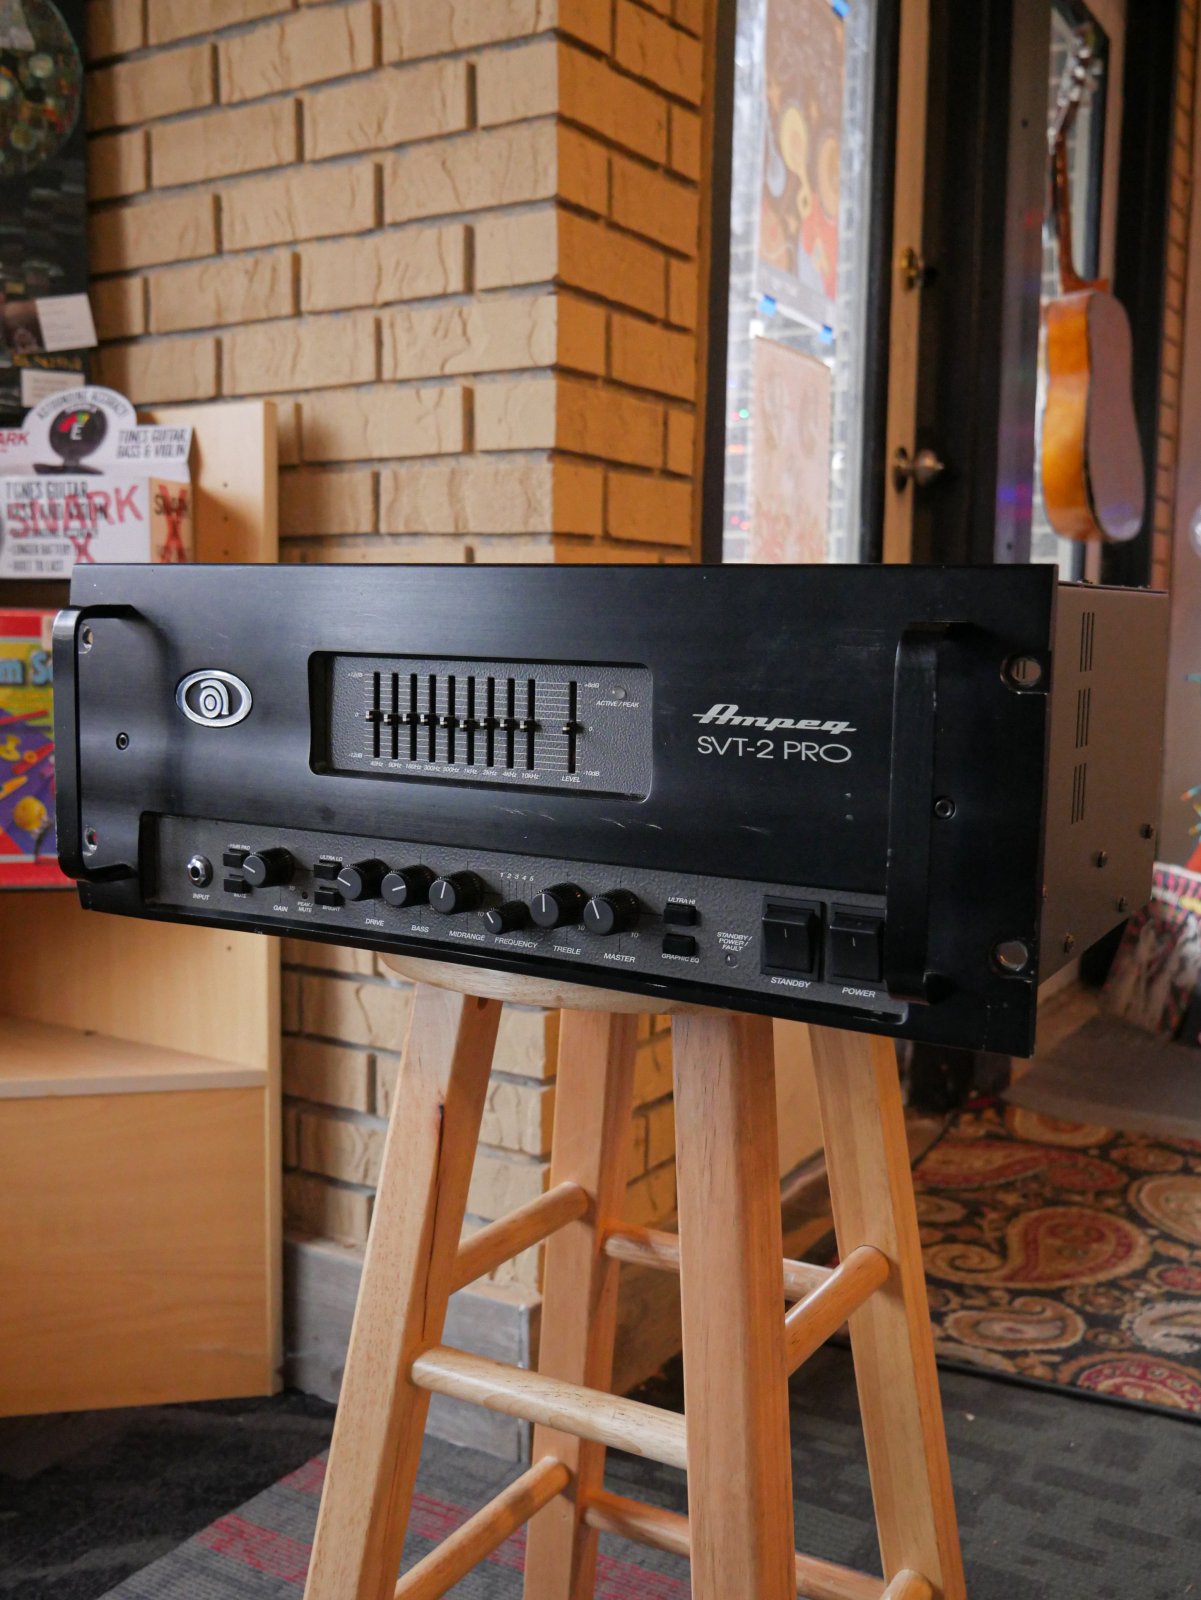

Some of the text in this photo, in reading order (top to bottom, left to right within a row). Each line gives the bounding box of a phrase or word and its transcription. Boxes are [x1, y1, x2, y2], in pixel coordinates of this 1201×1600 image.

[7, 485, 143, 539] SNARK
[692, 703, 857, 735] Ampeg
[697, 735, 852, 763] SVT-2 PRO
[561, 775, 581, 783] LEVEL
[193, 893, 210, 901] INPUT
[667, 896, 688, 905] ULTRA
[273, 904, 289, 913] GAIN
[365, 918, 385, 927] DRIVE
[411, 924, 430, 933] BASS
[448, 930, 486, 942] MIDRANGE
[494, 936, 539, 949] FREQUENCY
[721, 944, 744, 952] FAULT
[553, 944, 582, 956] TREBLE
[603, 952, 636, 964] MASTER
[661, 952, 690, 963] GRAPHIC
[770, 976, 812, 989] STANDBY
[841, 986, 877, 999] POWER
